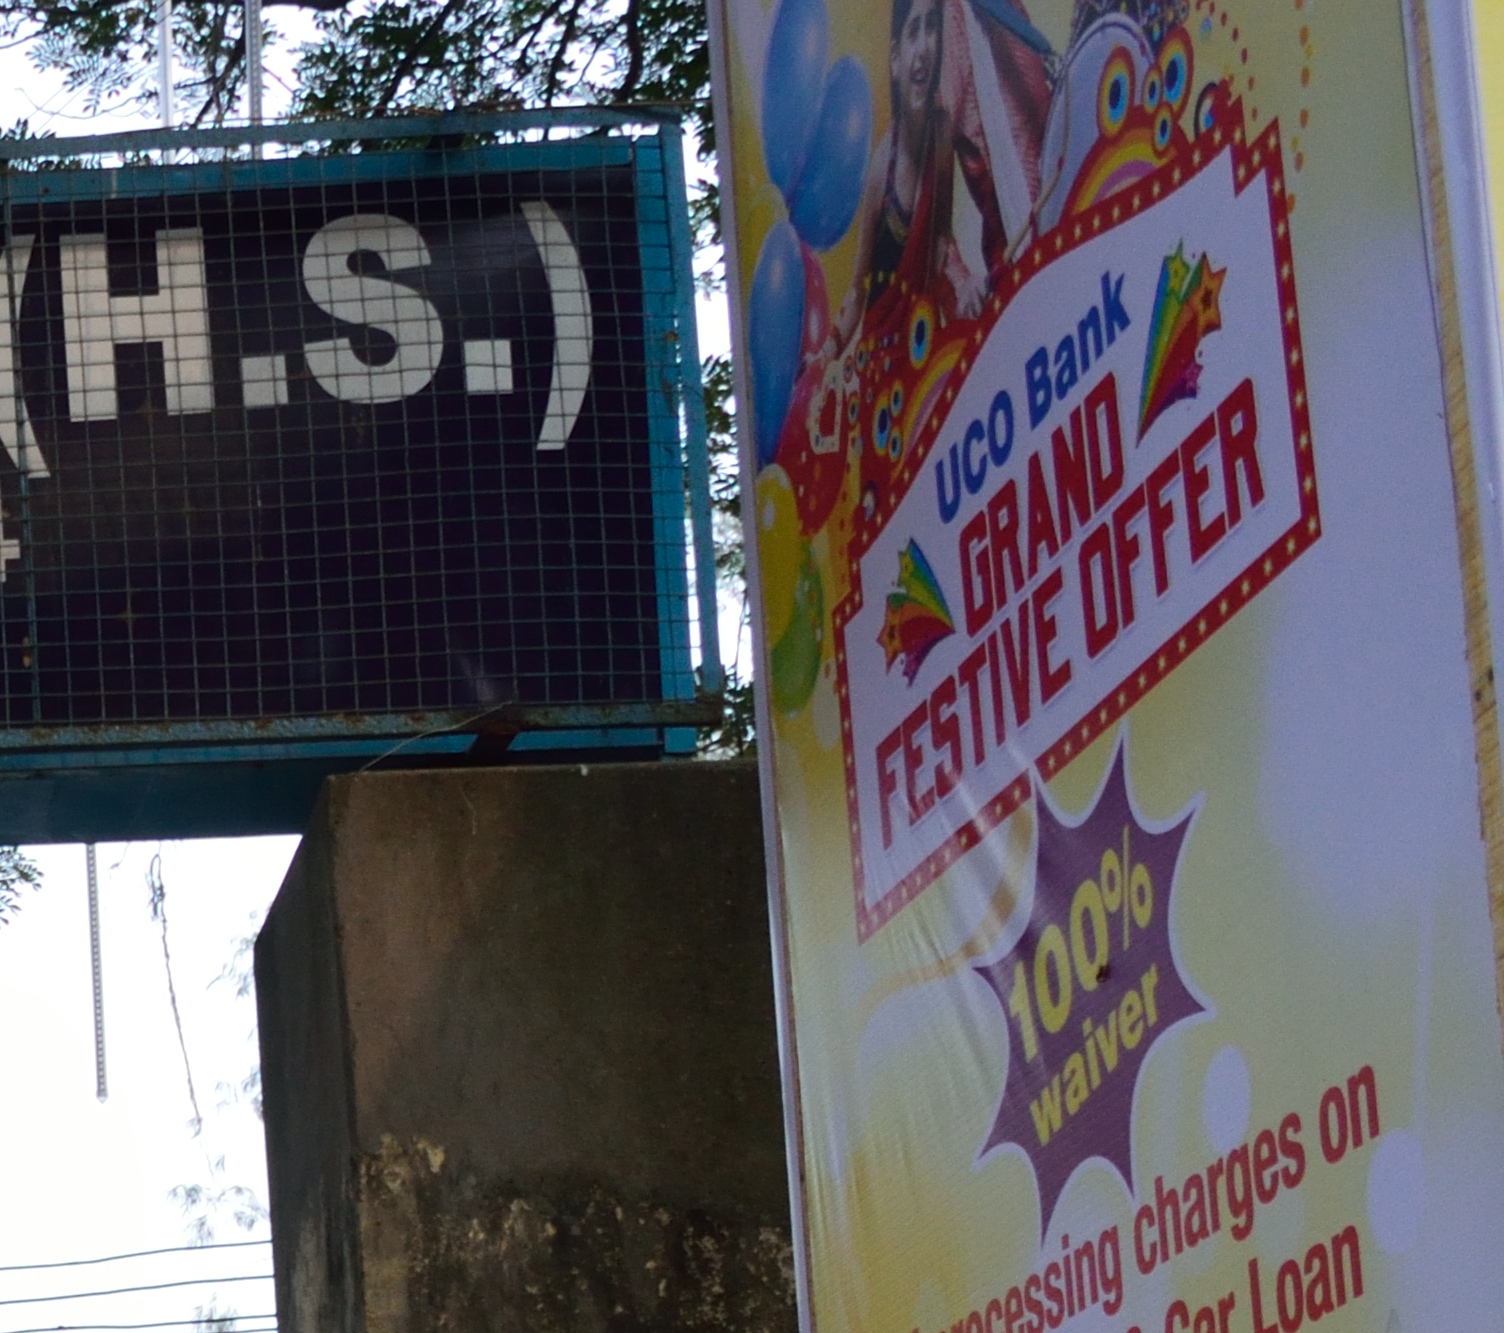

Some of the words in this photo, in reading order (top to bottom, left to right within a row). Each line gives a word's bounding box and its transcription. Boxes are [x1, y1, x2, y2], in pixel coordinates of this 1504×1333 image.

[934, 391, 1014, 525] UCO
[1024, 270, 1132, 431] Bank
[957, 371, 1126, 641] GRAND
[875, 565, 1073, 852] FESTIVE
[1077, 376, 1267, 656] OFFER
[1008, 826, 1154, 1064] 100%
[1030, 961, 1161, 1149] waiver
[1133, 1111, 1307, 1274] charges
[1318, 1064, 1381, 1163] on
